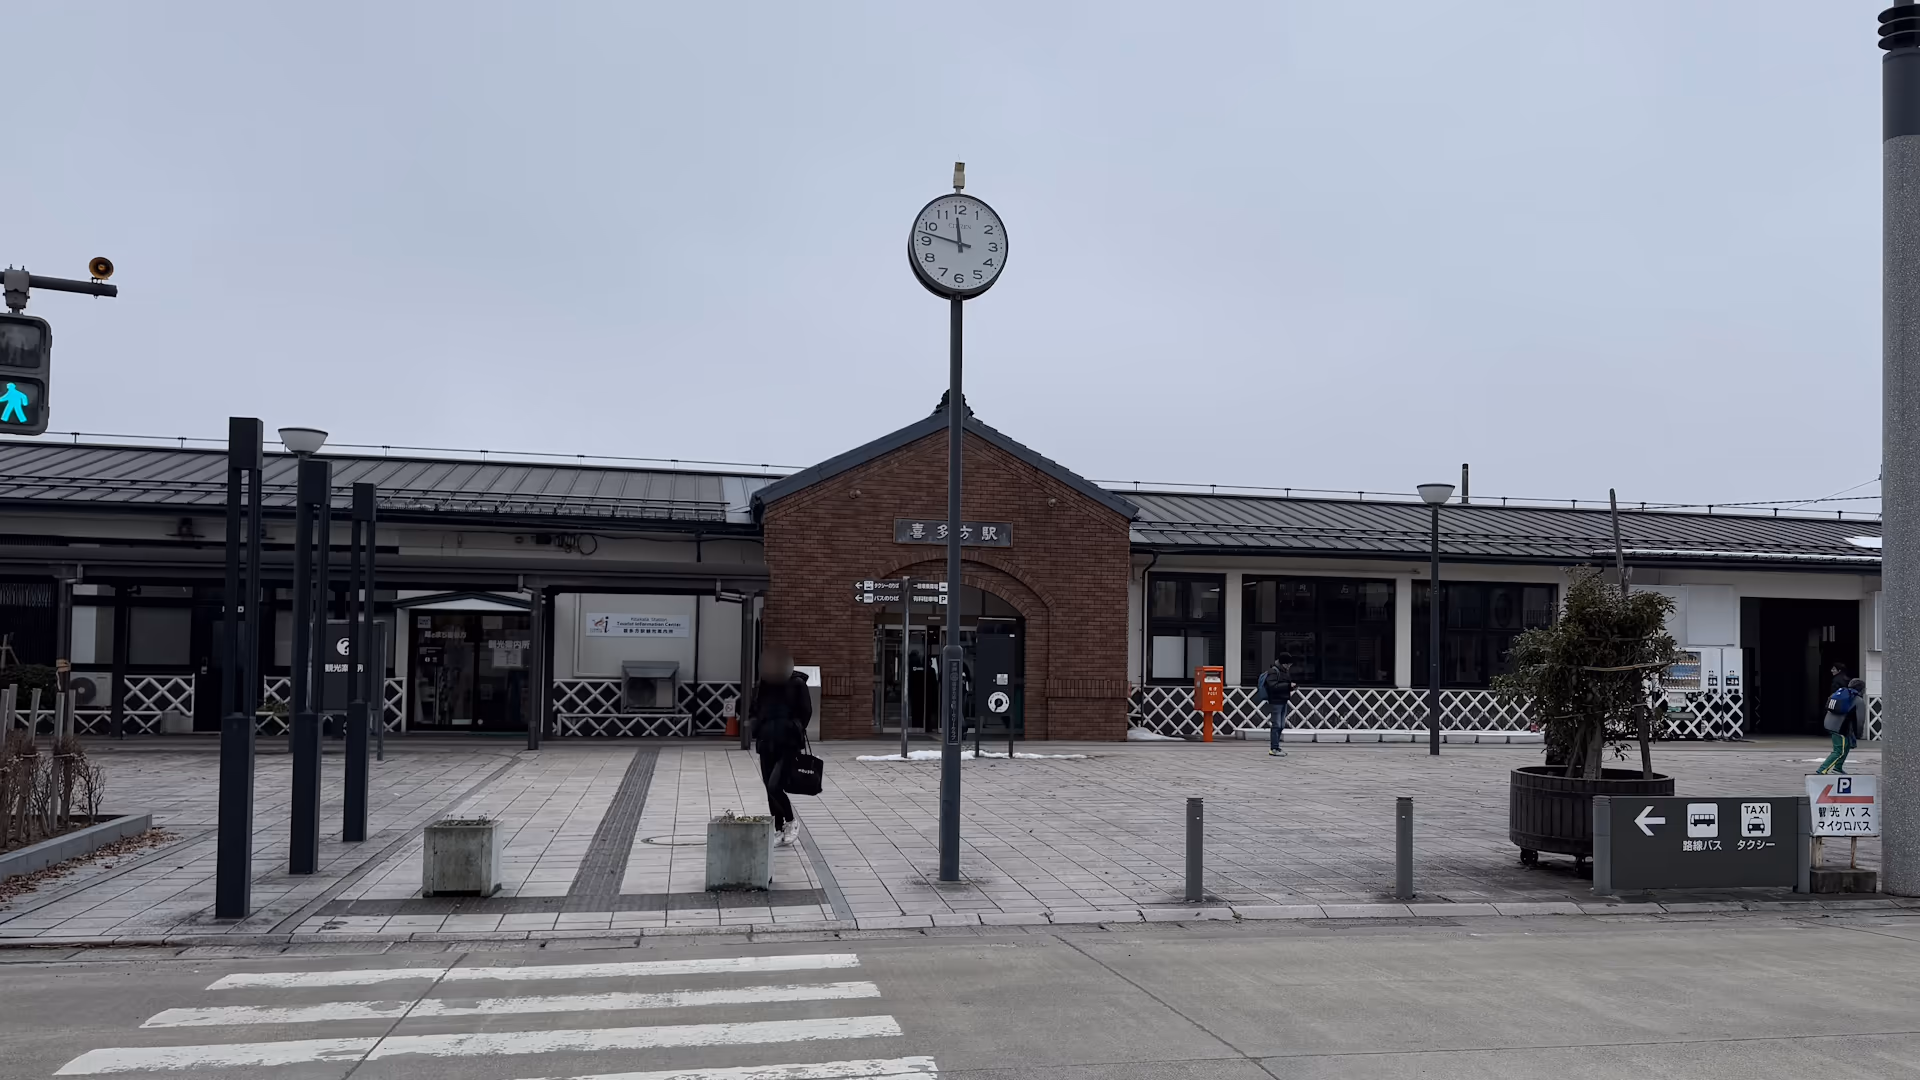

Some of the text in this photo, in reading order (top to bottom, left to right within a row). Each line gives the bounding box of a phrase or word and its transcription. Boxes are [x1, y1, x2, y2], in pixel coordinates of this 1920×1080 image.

[954, 204, 967, 215] 12
[936, 210, 948, 220] 11
[975, 210, 979, 220] 1
[924, 222, 938, 232] 10
[984, 225, 994, 235] 2
[921, 236, 932, 246] 9
[988, 242, 998, 252] 3
[924, 253, 935, 262] 8
[983, 258, 994, 267] 4
[938, 267, 949, 277] 7
[973, 270, 983, 280] 5
[954, 274, 964, 283] 6
[910, 523, 998, 540] 喜多方駅
[1839, 779, 1850, 793] P
[1744, 806, 1768, 814] TAXI
[1819, 807, 1871, 817] 観光バス
[1818, 821, 1871, 831] マイクロバス
[1682, 840, 1722, 851] 路線バス
[1737, 840, 1775, 850] タクシー
